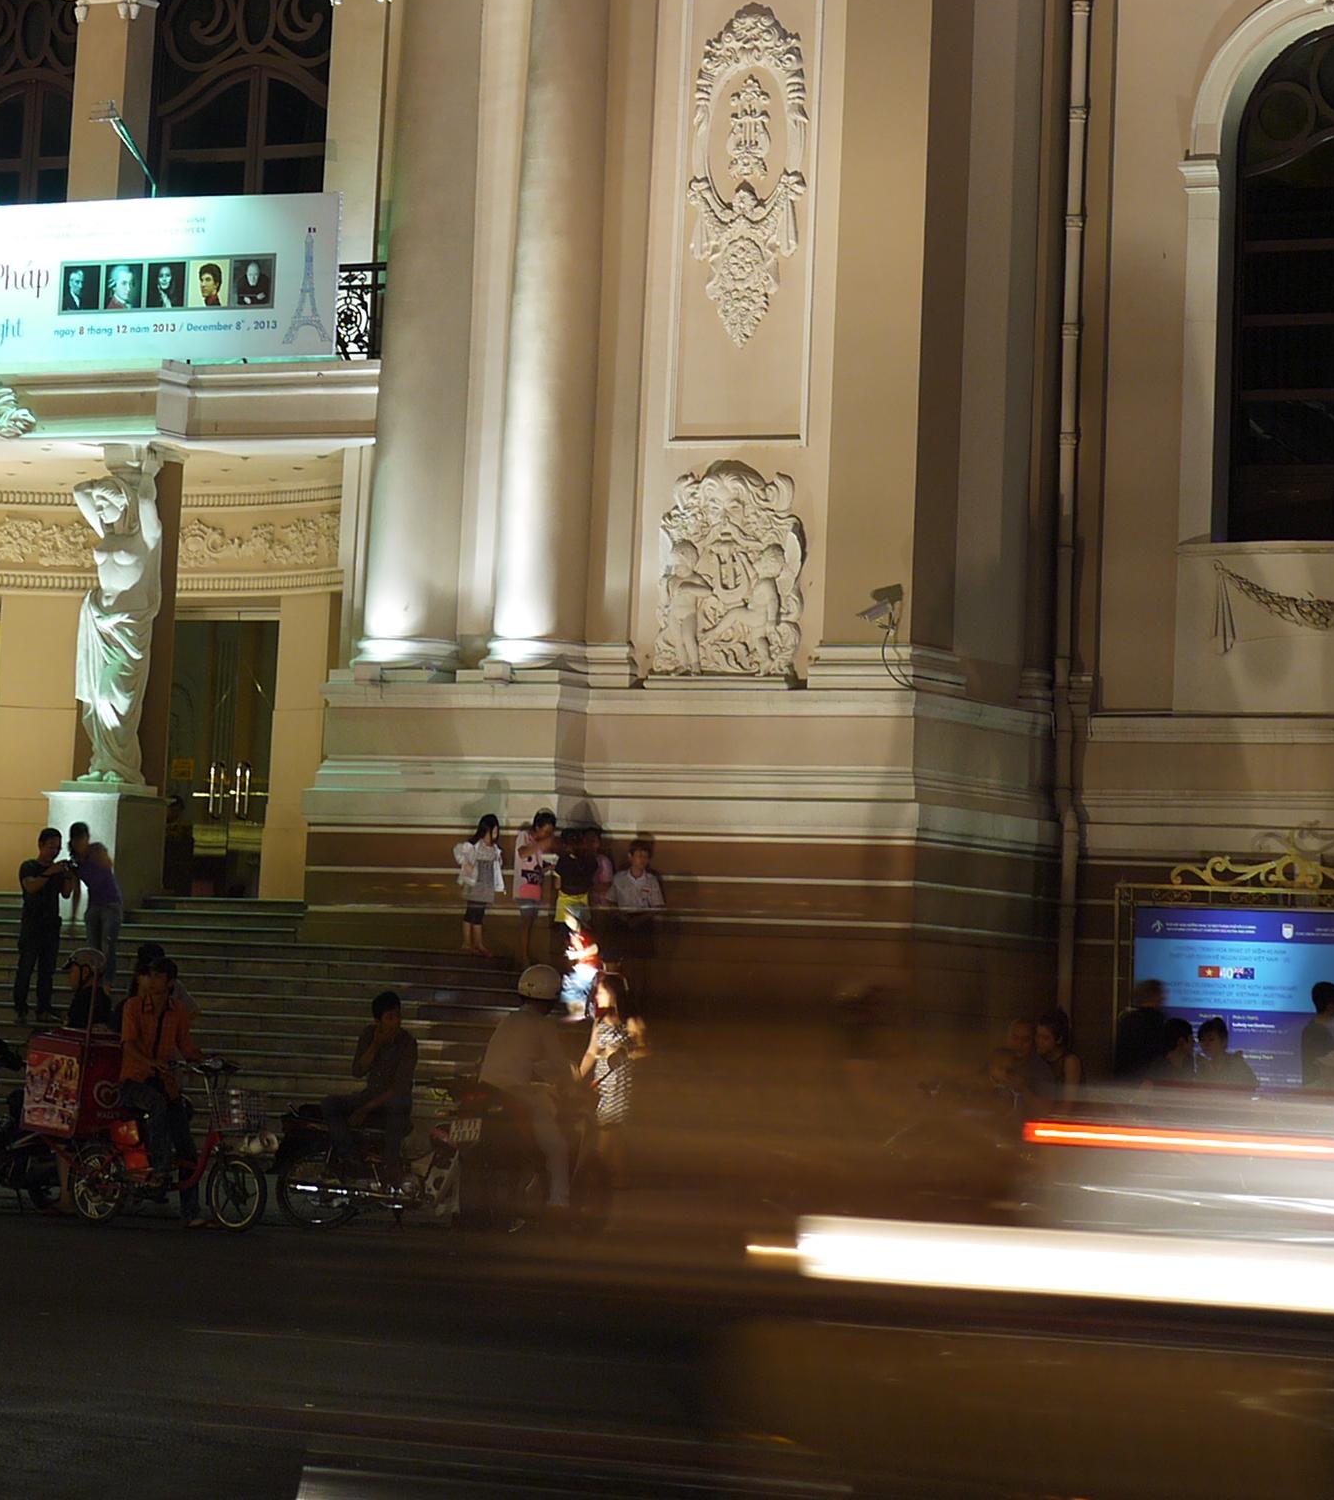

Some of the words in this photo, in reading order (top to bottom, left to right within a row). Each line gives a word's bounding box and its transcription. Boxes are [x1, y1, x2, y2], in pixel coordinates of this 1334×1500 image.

[78, 325, 84, 336] 8
[116, 324, 127, 334] 12
[152, 323, 176, 333] 2013
[187, 321, 233, 331] December
[253, 320, 277, 330] 2013
